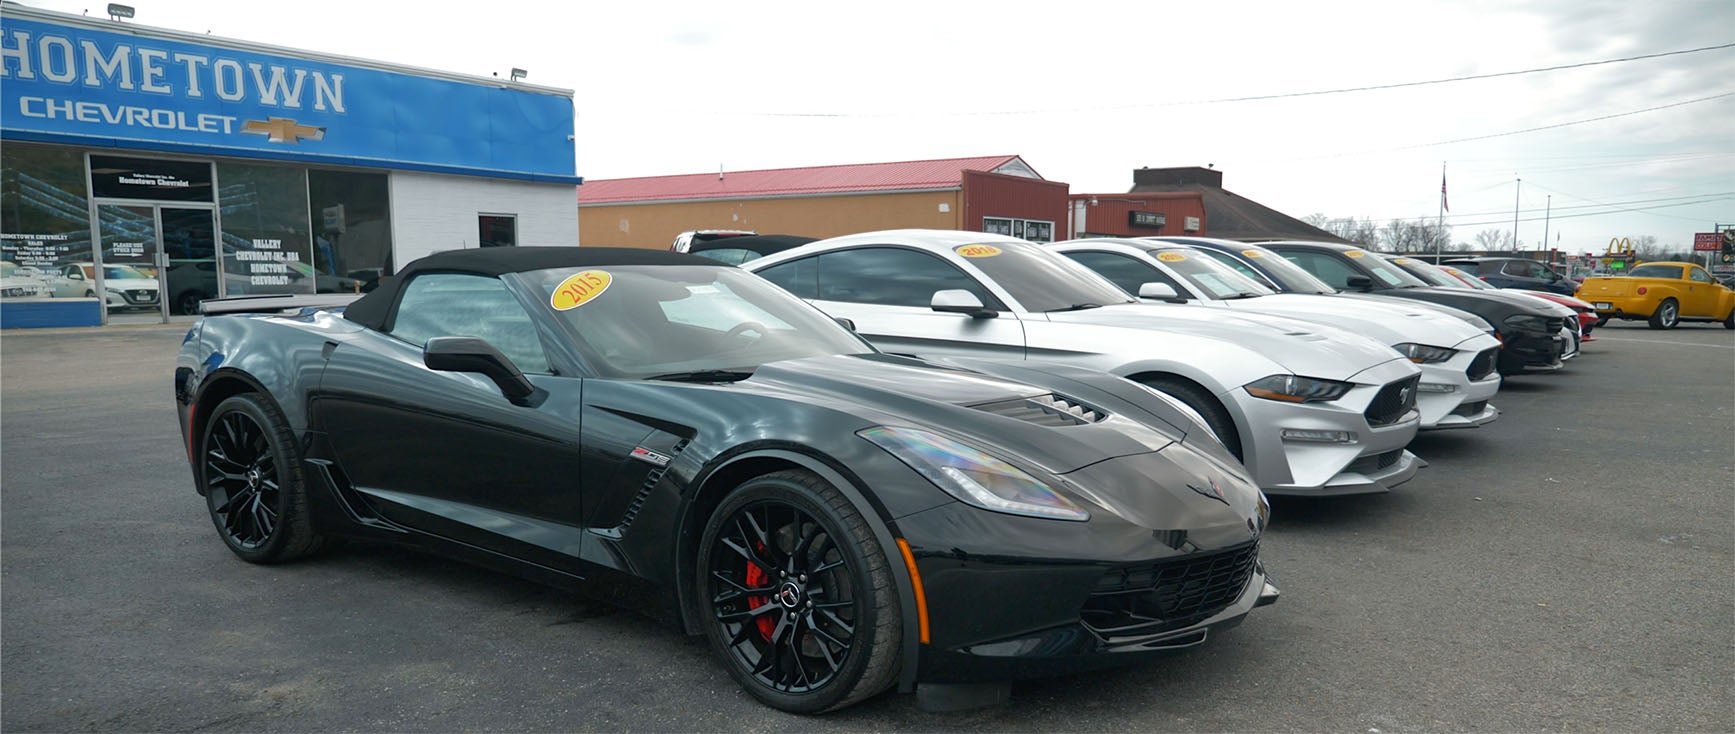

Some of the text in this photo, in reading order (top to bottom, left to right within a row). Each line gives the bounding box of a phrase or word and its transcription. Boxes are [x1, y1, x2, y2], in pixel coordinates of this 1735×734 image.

[0, 29, 347, 114] HOMETOWN
[19, 95, 237, 134] CHEVROLET
[119, 176, 189, 187] Hometown Chevrolet
[252, 239, 282, 249] VALLERY
[286, 251, 300, 261] DBA
[250, 263, 287, 273] HOMETOWN
[251, 275, 288, 285] CHEVROLET
[562, 273, 602, 304] 2015
[631, 446, 671, 466] Z06
